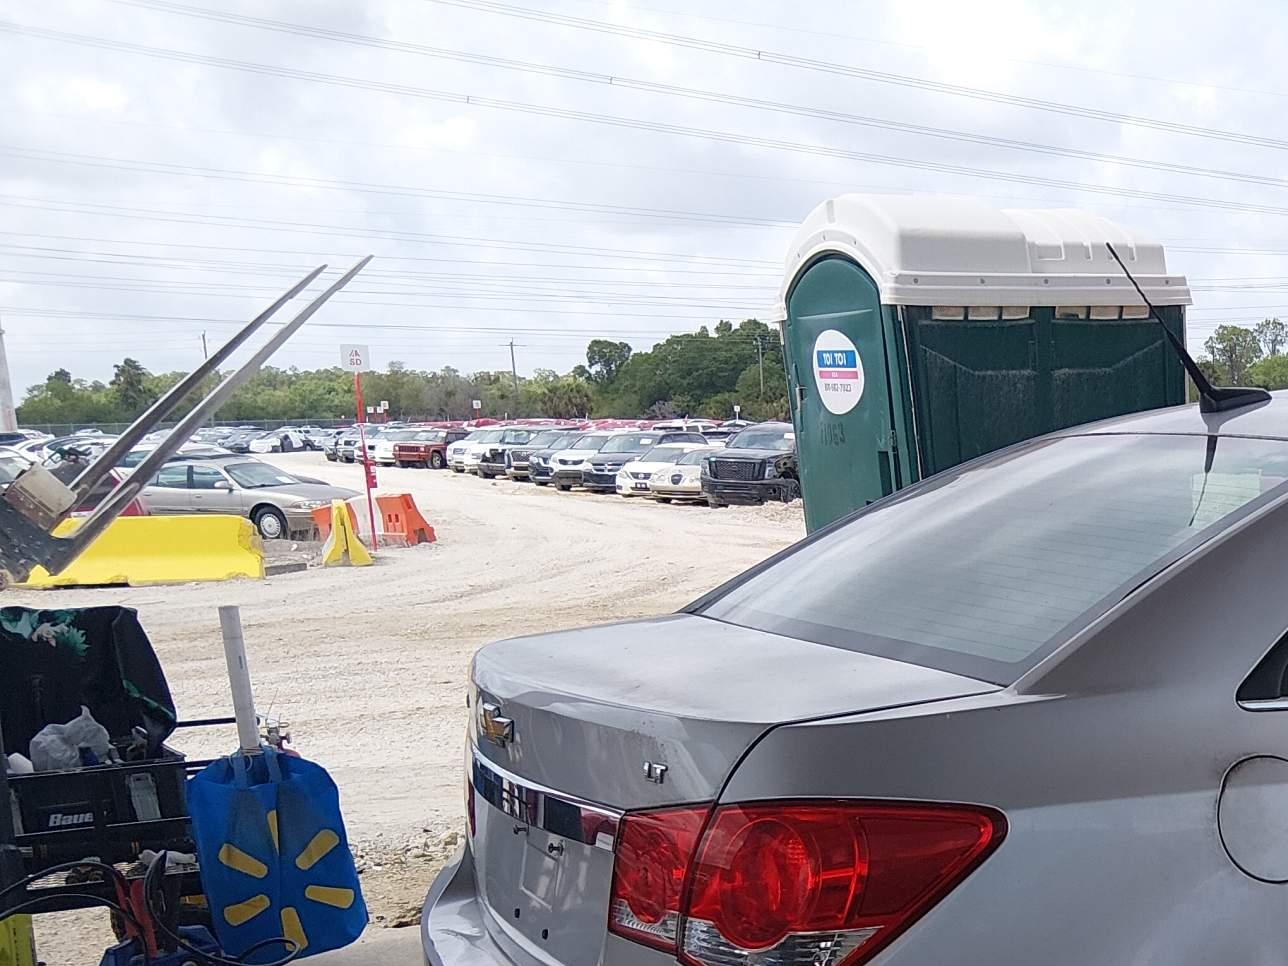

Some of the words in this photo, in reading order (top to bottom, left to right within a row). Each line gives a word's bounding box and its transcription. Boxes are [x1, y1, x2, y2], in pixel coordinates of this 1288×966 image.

[822, 352, 833, 366] TOI
[834, 352, 847, 366] TOI
[643, 761, 668, 784] LT
